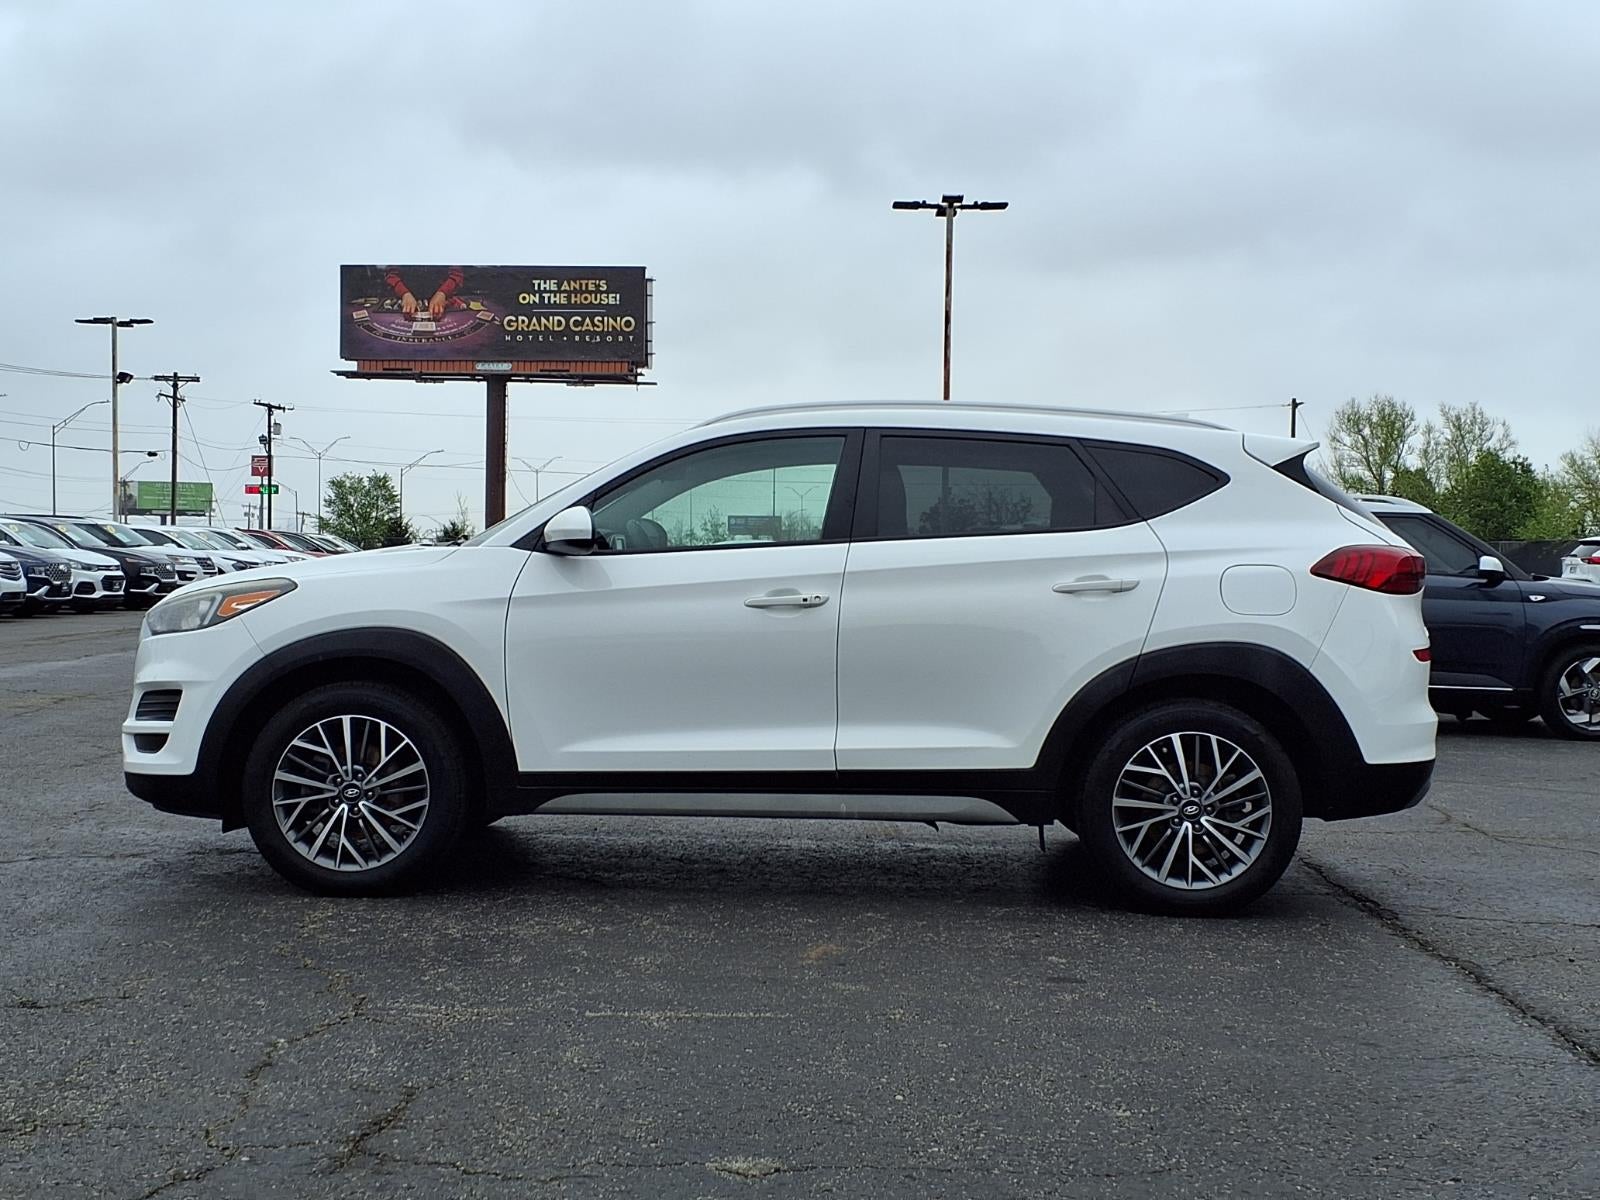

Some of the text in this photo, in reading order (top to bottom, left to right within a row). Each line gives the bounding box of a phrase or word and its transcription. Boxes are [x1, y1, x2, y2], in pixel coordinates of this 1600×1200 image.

[532, 279, 608, 291] THE ANTE'S
[518, 293, 620, 305] ON THE HOUSE!
[503, 315, 636, 332] GRAND CASINO
[574, 335, 635, 343] RESORT
